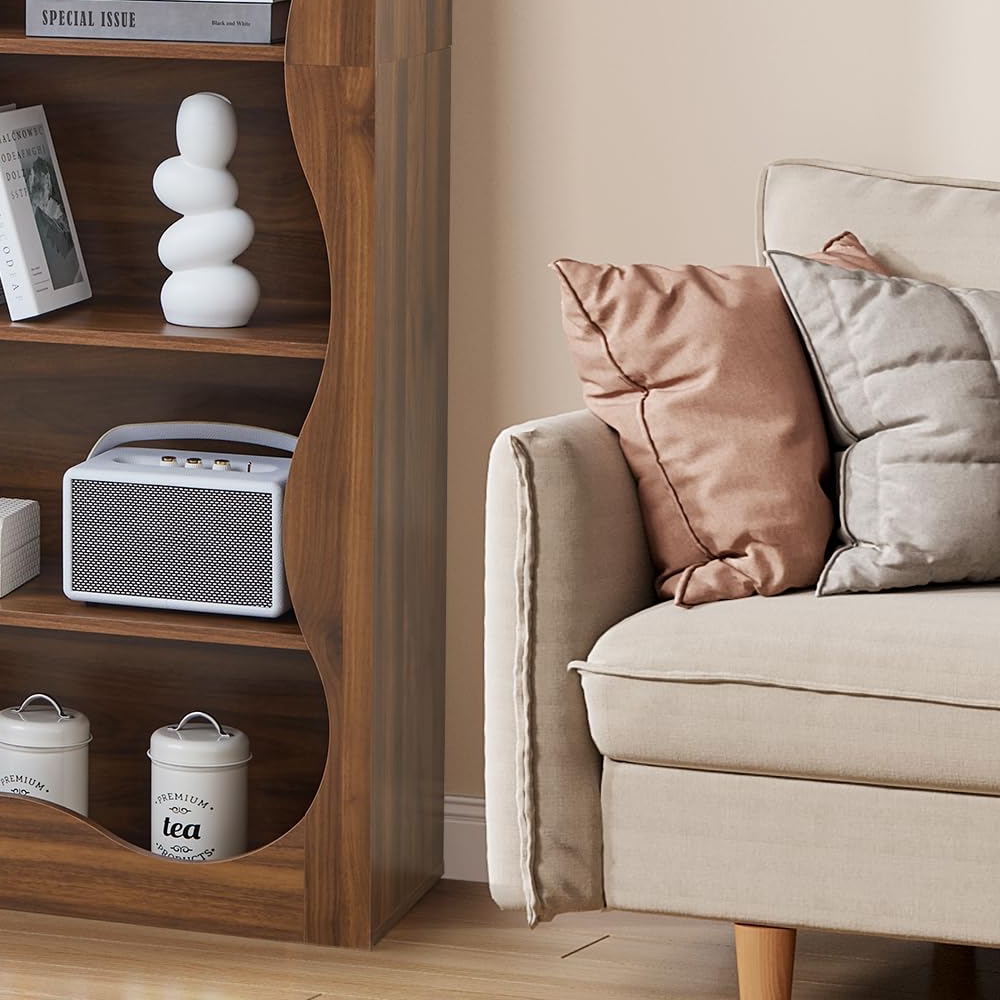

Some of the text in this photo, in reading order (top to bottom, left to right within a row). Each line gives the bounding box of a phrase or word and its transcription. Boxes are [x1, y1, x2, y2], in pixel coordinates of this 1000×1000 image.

[42, 10, 136, 28] SPECIAL ISSUE
[0, 775, 45, 791] PREMIUM
[157, 792, 208, 808] PREMIUM
[163, 817, 201, 839] tea
